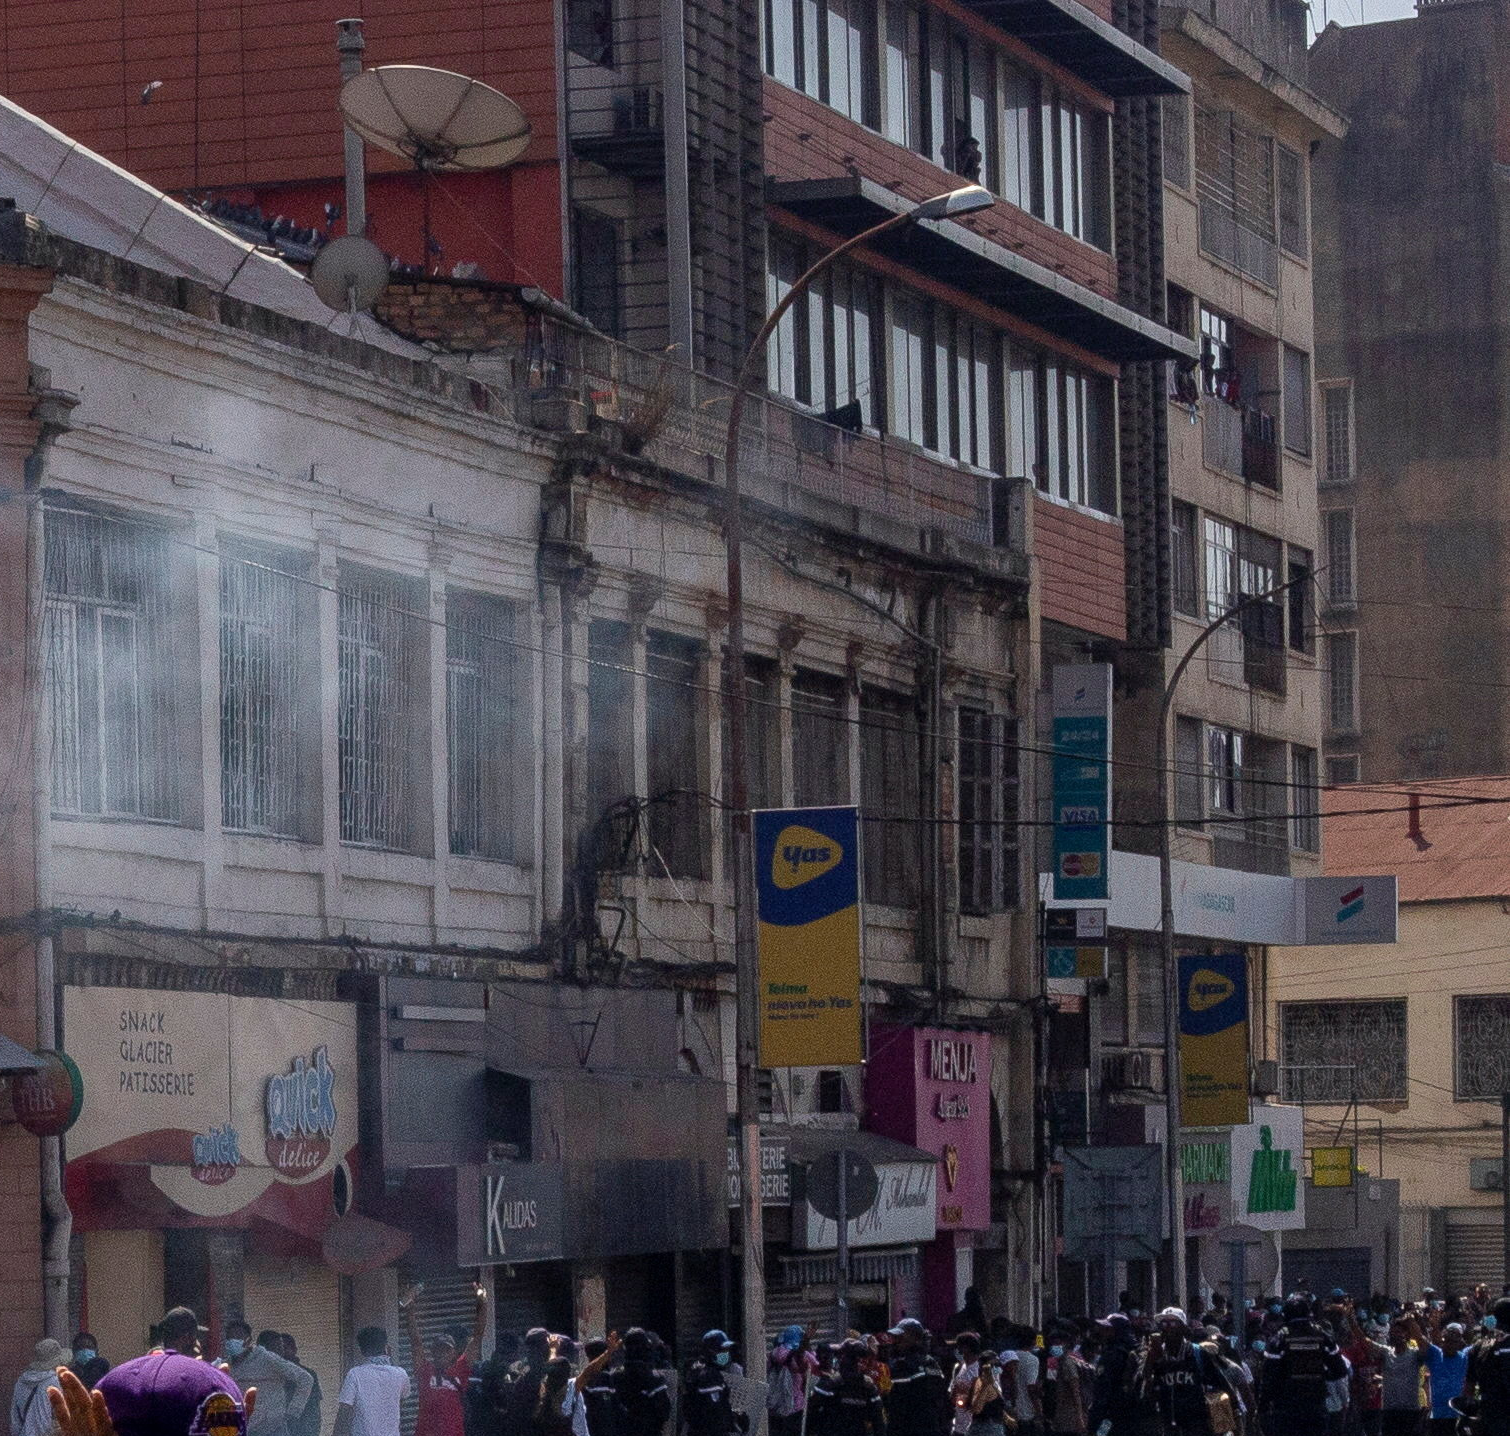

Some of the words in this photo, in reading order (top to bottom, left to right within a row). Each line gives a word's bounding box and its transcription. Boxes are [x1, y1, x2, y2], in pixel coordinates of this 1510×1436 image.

[1063, 809, 1096, 823] VISA
[119, 1010, 166, 1034] SNACK
[119, 1040, 174, 1065] GLACIER
[931, 1039, 977, 1083] MENJA
[119, 1071, 195, 1096] PATISSERIE
[487, 1175, 537, 1256] KALIDAS
